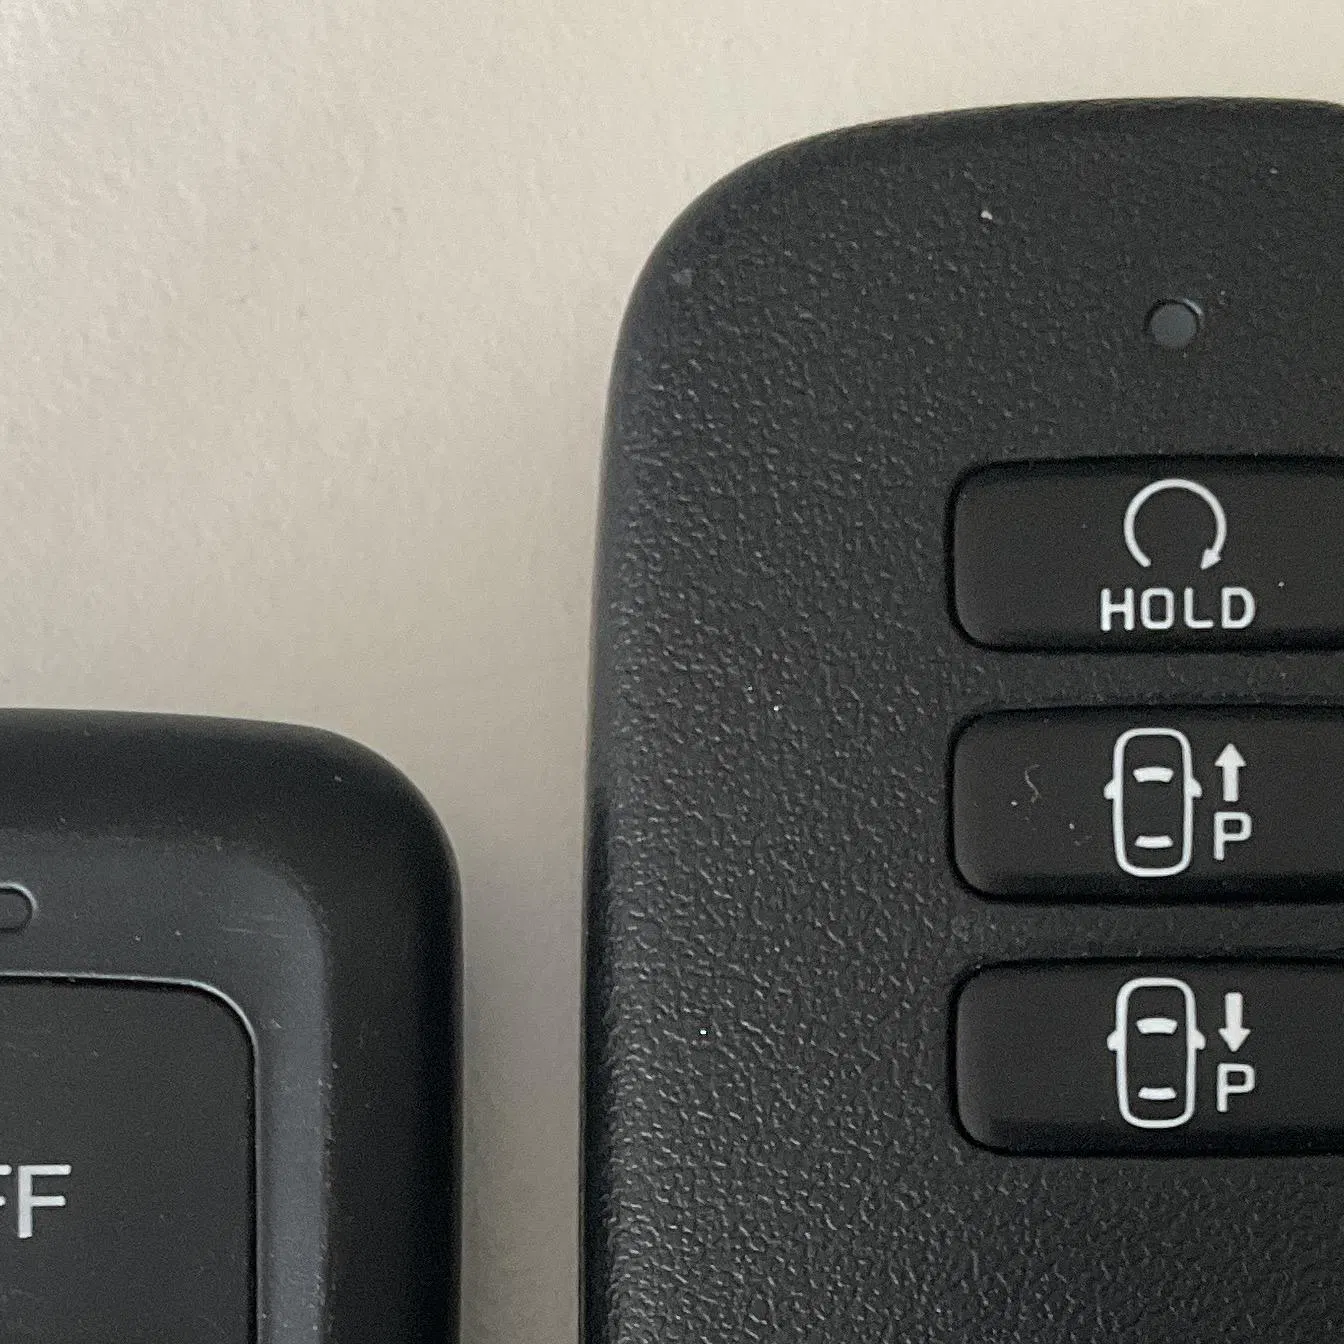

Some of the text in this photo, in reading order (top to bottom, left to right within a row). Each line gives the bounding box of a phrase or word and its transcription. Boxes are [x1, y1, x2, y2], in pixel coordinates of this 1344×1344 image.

[1099, 585, 1258, 633] HOLD
[1212, 810, 1254, 862] P
[1215, 1061, 1257, 1114] P
